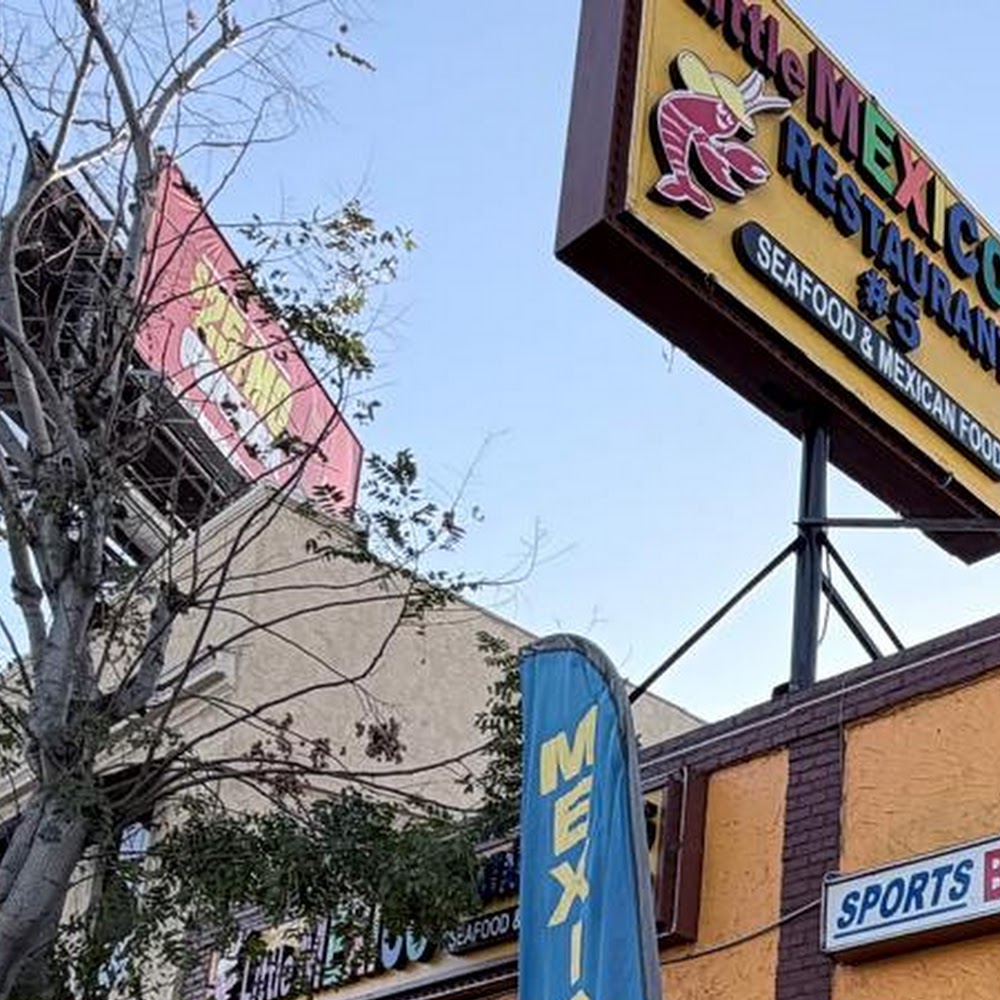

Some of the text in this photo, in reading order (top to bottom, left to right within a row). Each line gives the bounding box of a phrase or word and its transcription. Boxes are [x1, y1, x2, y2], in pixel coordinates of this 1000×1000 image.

[757, 234, 856, 342] SEAFOOD
[860, 326, 874, 362] &
[878, 340, 956, 430] MEXICAN
[837, 858, 974, 930] SPORTS
